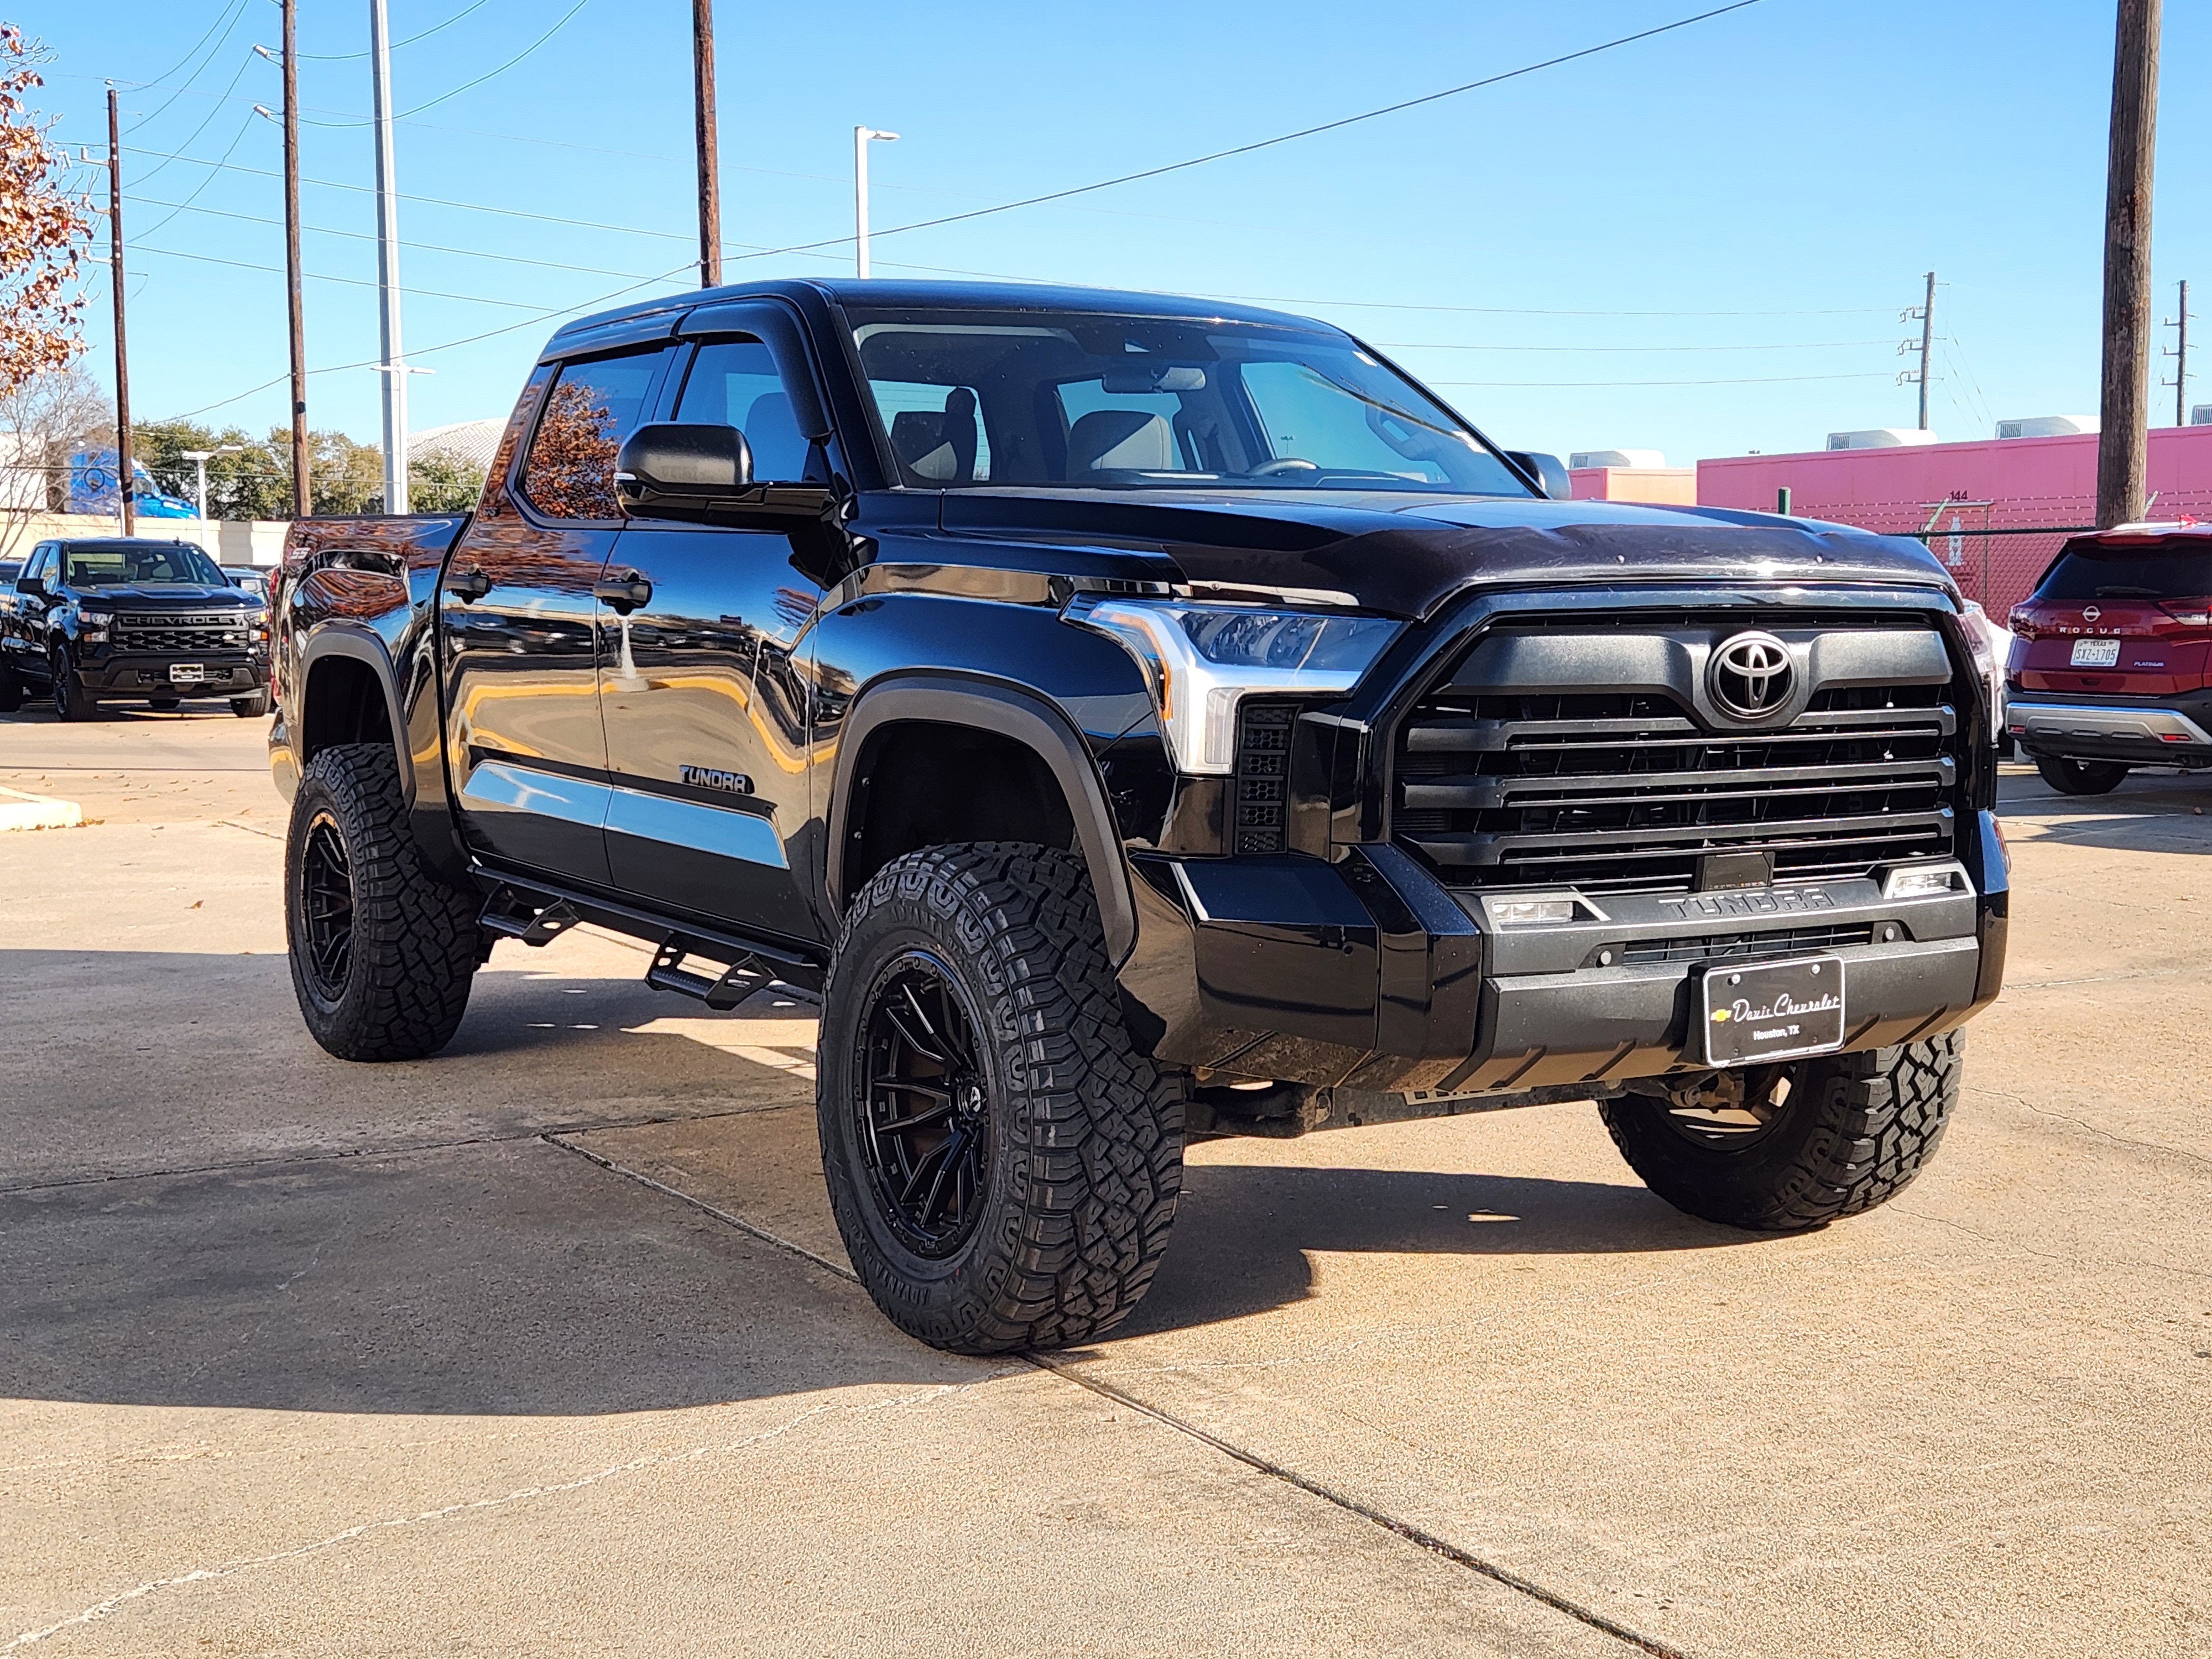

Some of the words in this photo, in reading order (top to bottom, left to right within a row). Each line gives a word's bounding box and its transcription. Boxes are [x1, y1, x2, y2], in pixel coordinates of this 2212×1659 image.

[1950, 490, 1968, 502] 144
[679, 765, 746, 794] TUNDRA
[1657, 888, 1835, 919] TUNDRA
[1733, 998, 1774, 1022] Davis
[1773, 993, 1841, 1016] Chevrolet
[1753, 1027, 1788, 1040] Houston,
[1787, 1025, 1800, 1035] TX
